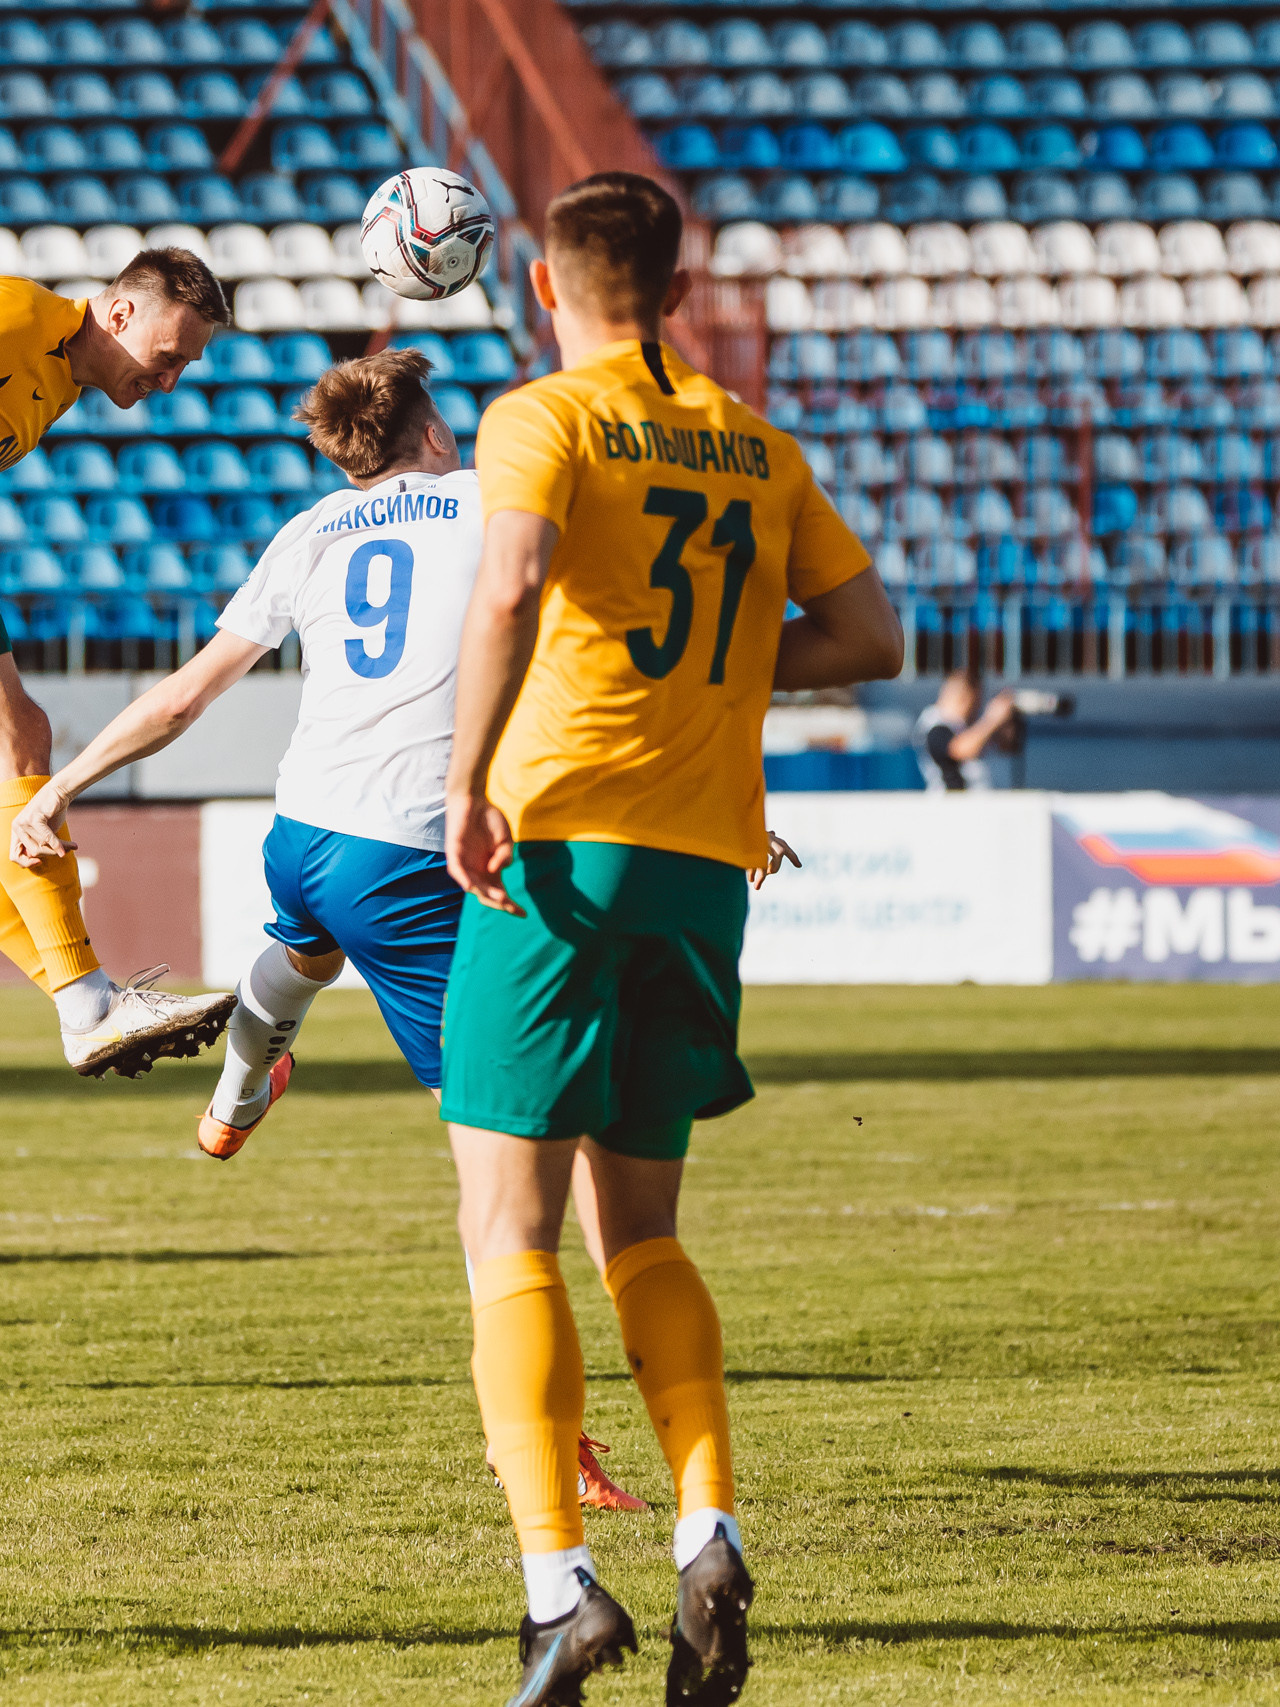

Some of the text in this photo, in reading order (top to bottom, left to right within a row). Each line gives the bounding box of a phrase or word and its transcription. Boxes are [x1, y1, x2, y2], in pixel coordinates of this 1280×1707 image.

[599, 420, 769, 481] БОЛЬШАКОВ
[344, 538, 415, 680] 9
[626, 486, 756, 685] 31
